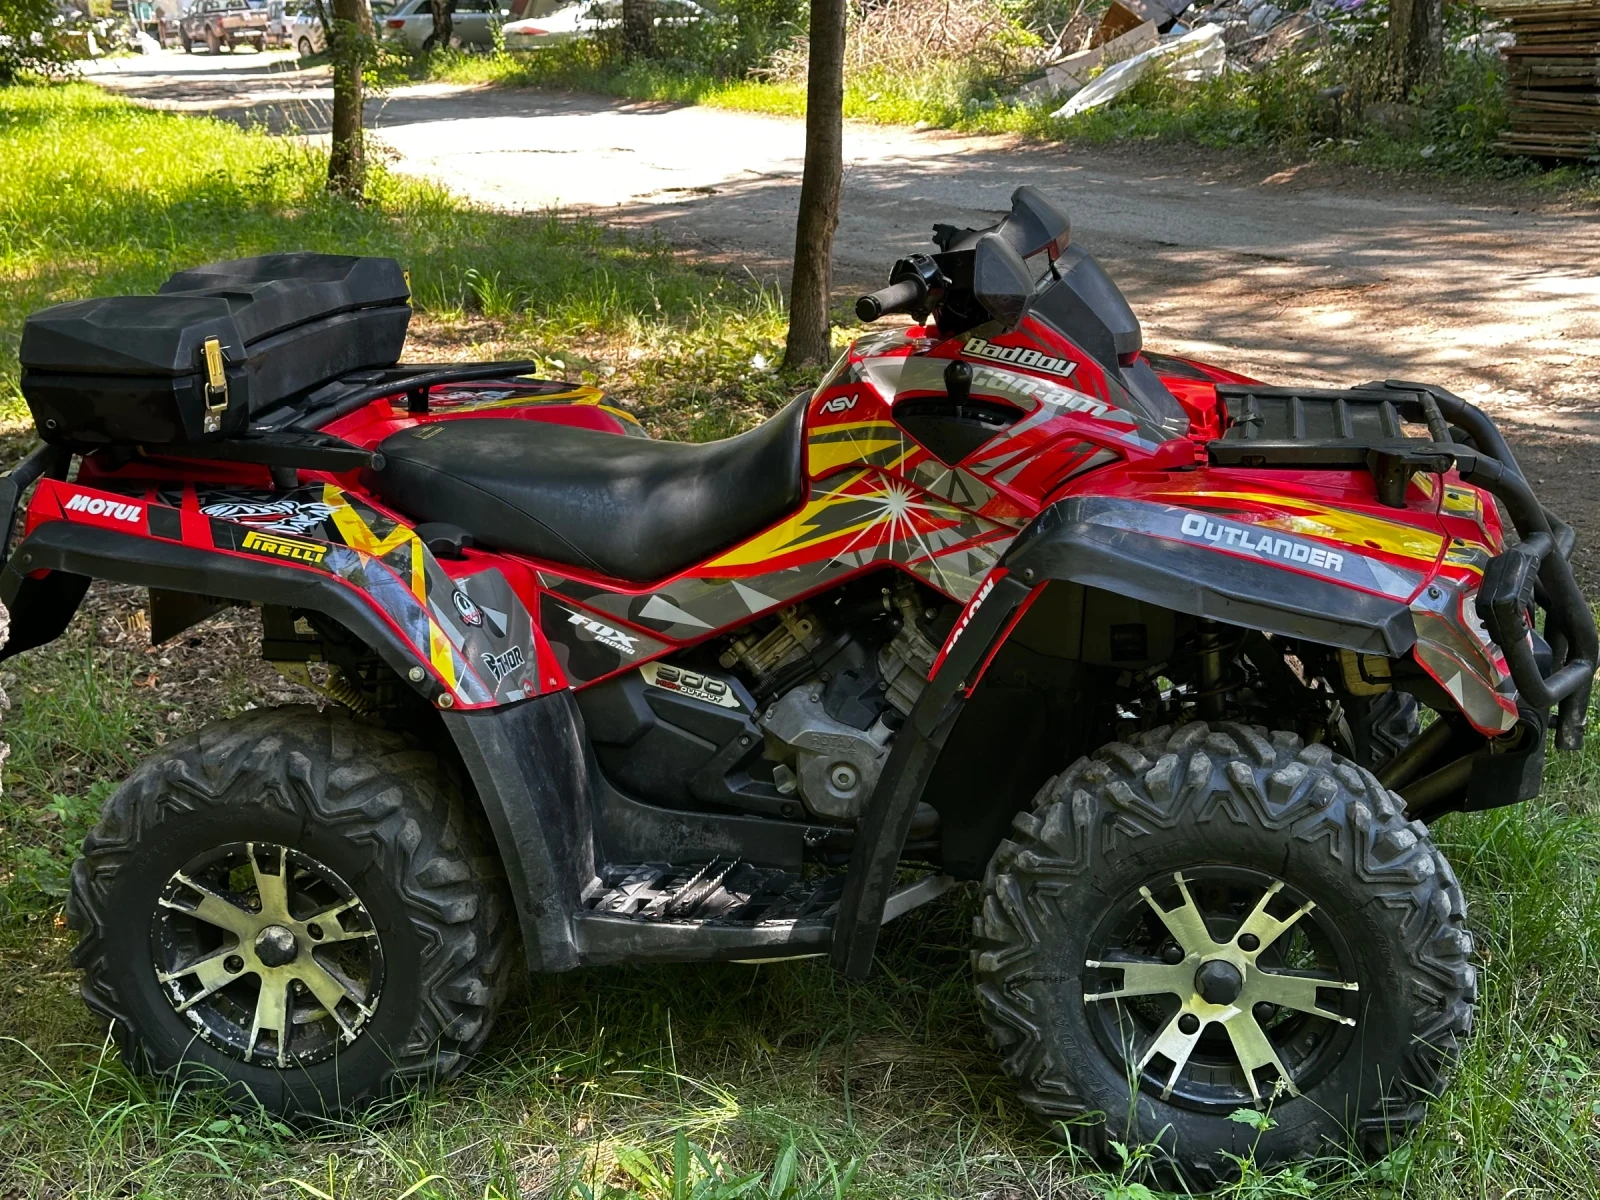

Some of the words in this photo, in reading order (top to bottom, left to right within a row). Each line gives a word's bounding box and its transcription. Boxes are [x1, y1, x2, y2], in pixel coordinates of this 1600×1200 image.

[961, 337, 1078, 378] BadBoy
[819, 394, 859, 415] ASV
[972, 366, 1109, 417] can-am
[65, 494, 142, 523] MOTUL
[241, 531, 328, 564] PIRELLI
[1180, 513, 1345, 573] OUTLANDER
[554, 603, 640, 649] FOX
[496, 645, 525, 677] THOR
[594, 635, 636, 655] RACING
[680, 686, 723, 703] OUTPUT
